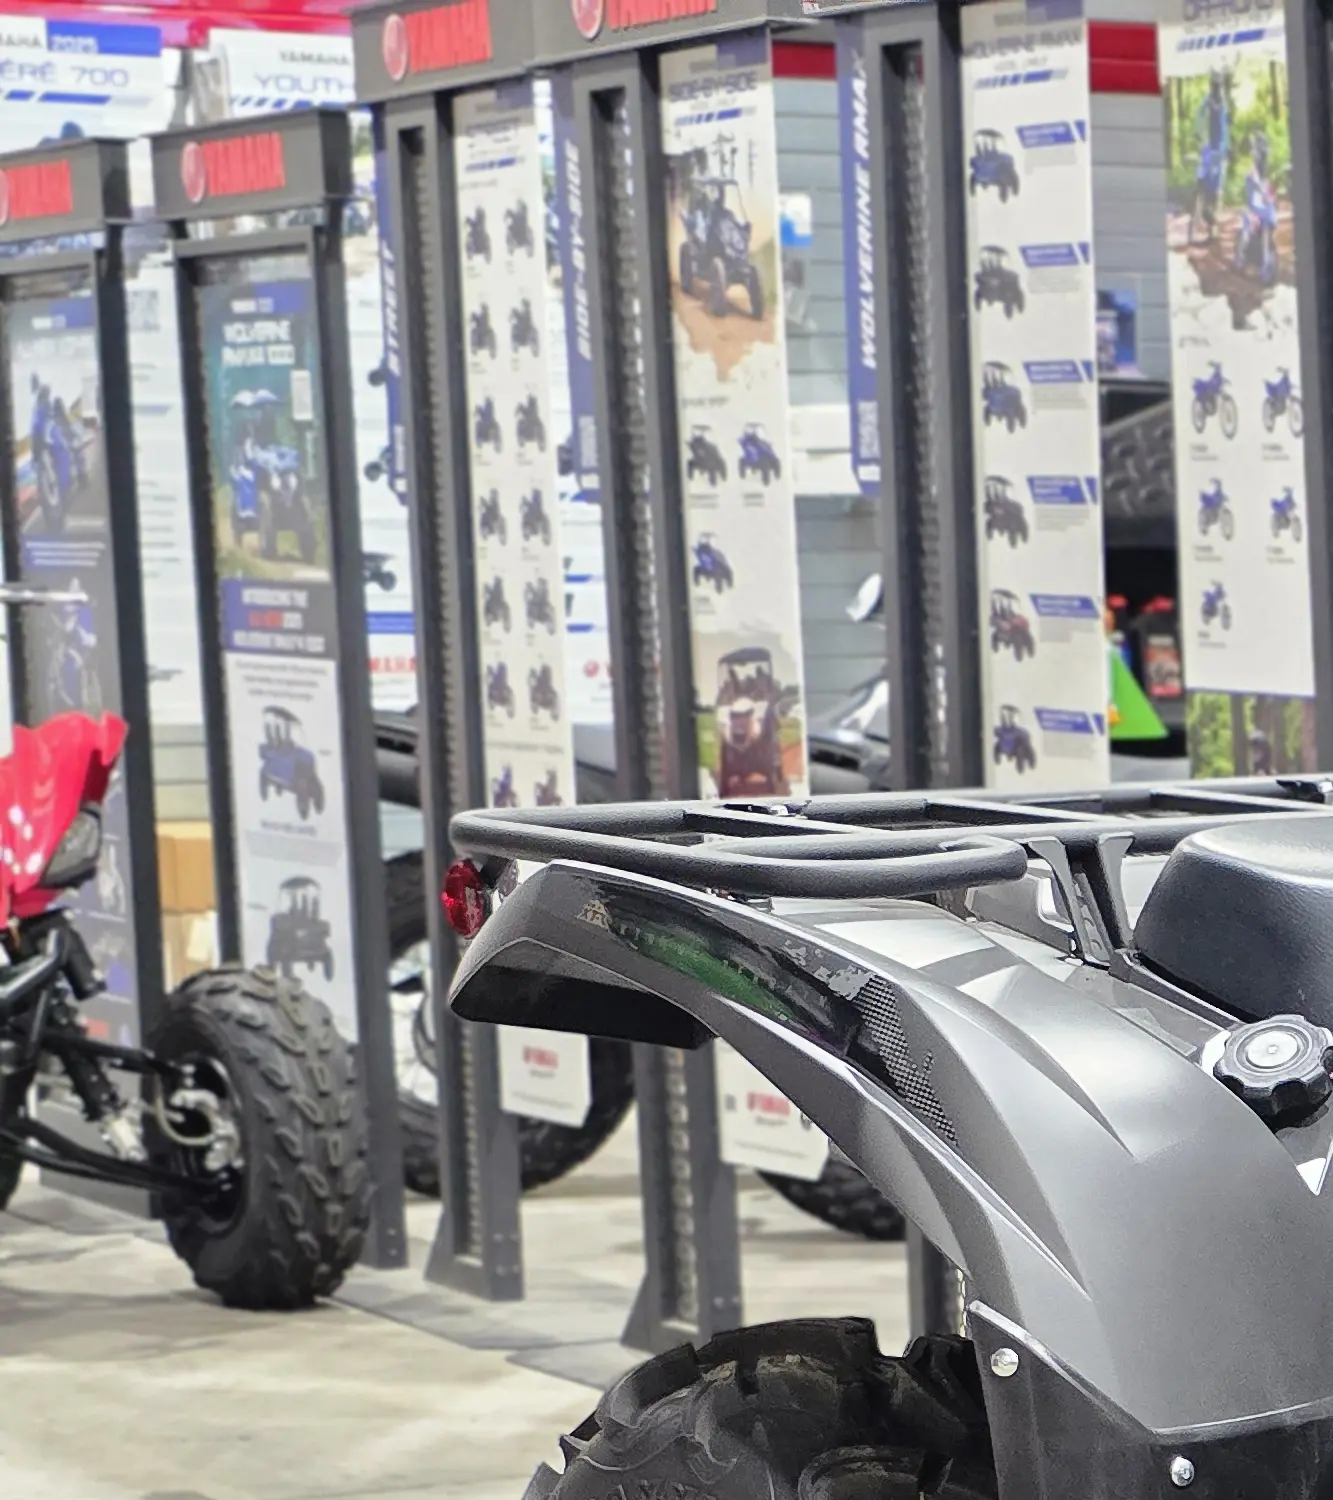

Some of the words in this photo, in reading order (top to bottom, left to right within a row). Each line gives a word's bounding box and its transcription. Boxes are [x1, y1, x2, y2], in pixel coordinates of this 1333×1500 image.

[69, 66, 130, 88] 700
[850, 48, 870, 160] RMAX
[565, 138, 593, 362] SIDE-BY-SIDE
[854, 160, 878, 370] WOLVERINE
